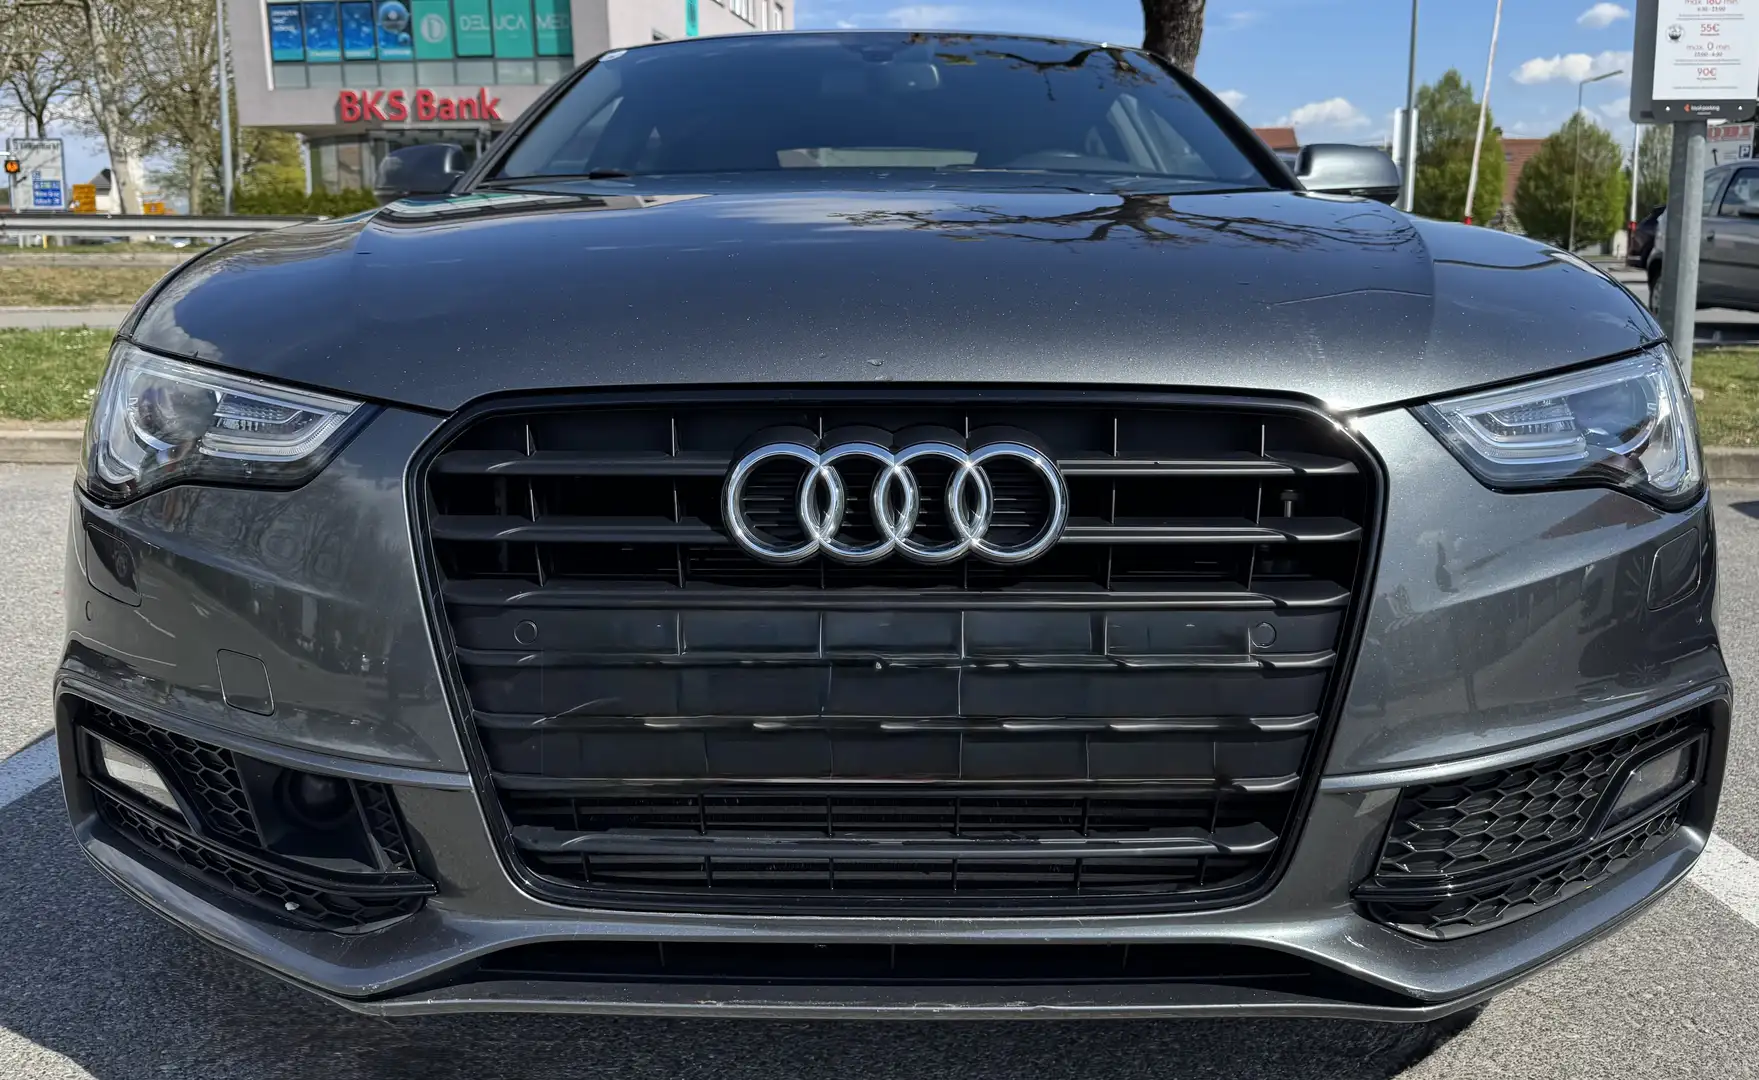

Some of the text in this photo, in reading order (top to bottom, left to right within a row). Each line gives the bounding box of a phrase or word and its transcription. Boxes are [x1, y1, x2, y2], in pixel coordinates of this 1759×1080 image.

[1700, 23, 1720, 32] 55€
[1707, 41, 1714, 51] 0
[1697, 67, 1717, 76] 90€
[339, 87, 503, 122] BKS Bank
